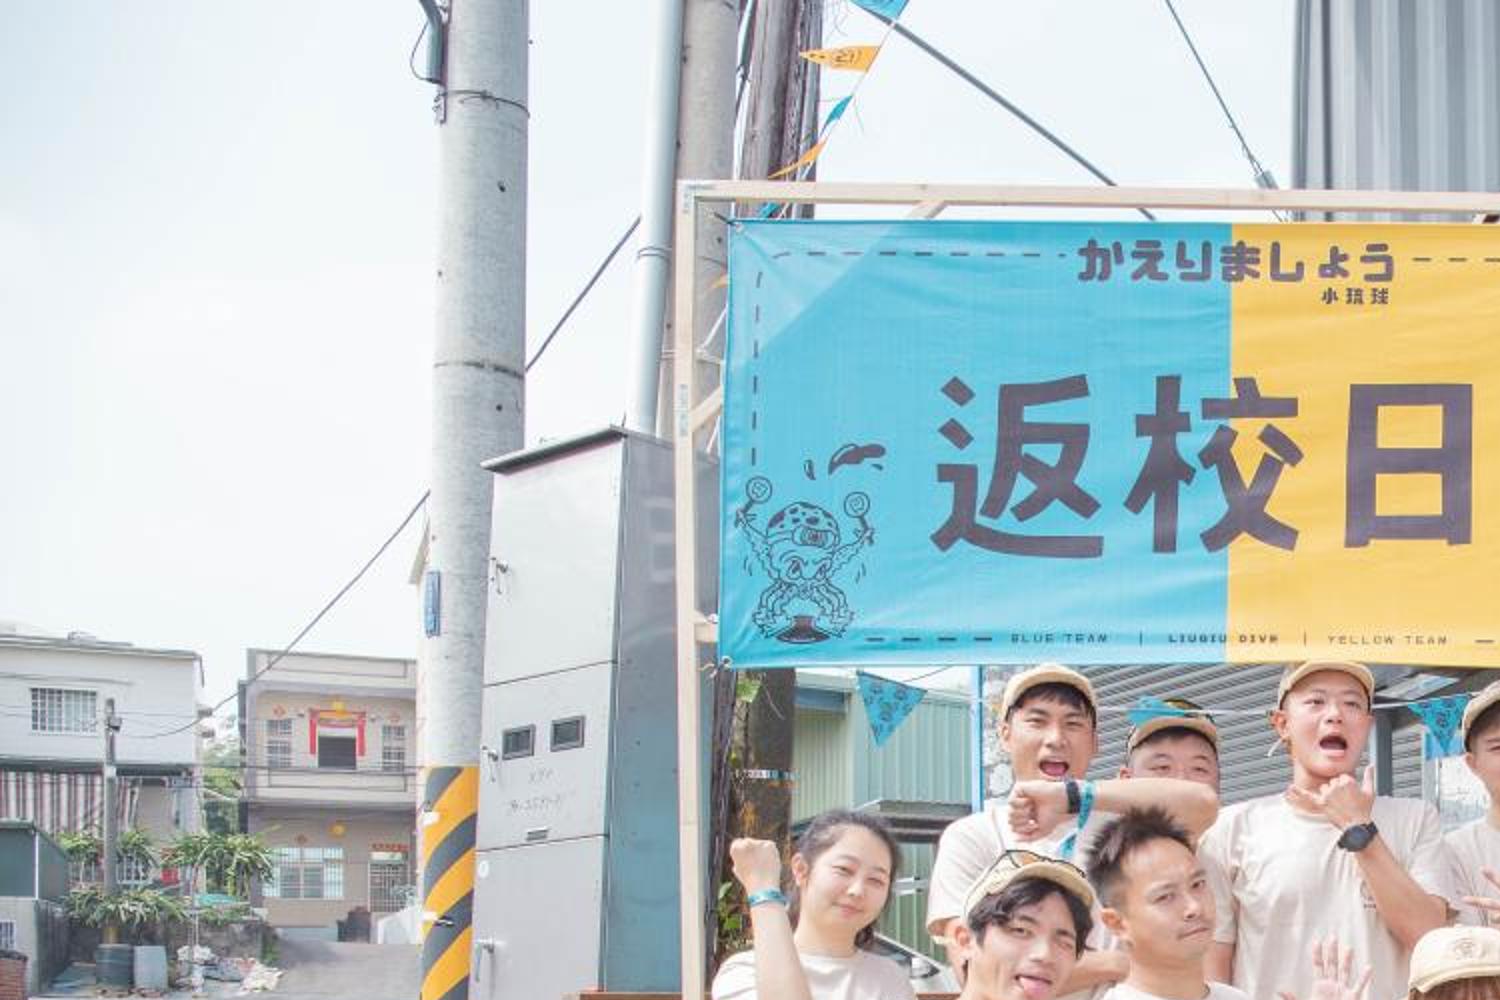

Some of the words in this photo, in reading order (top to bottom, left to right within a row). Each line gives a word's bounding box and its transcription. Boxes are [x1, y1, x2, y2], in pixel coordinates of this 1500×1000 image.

[1077, 237, 1395, 282] かえりましょう
[1321, 287, 1390, 306] 小琉球
[930, 373, 1474, 560] 返校日
[1011, 633, 1054, 644] BLUE
[1062, 633, 1107, 643] TEAM
[1239, 633, 1279, 644] DIVE
[1328, 635, 1393, 645] YELLOW
[1404, 635, 1447, 646] TEAM
